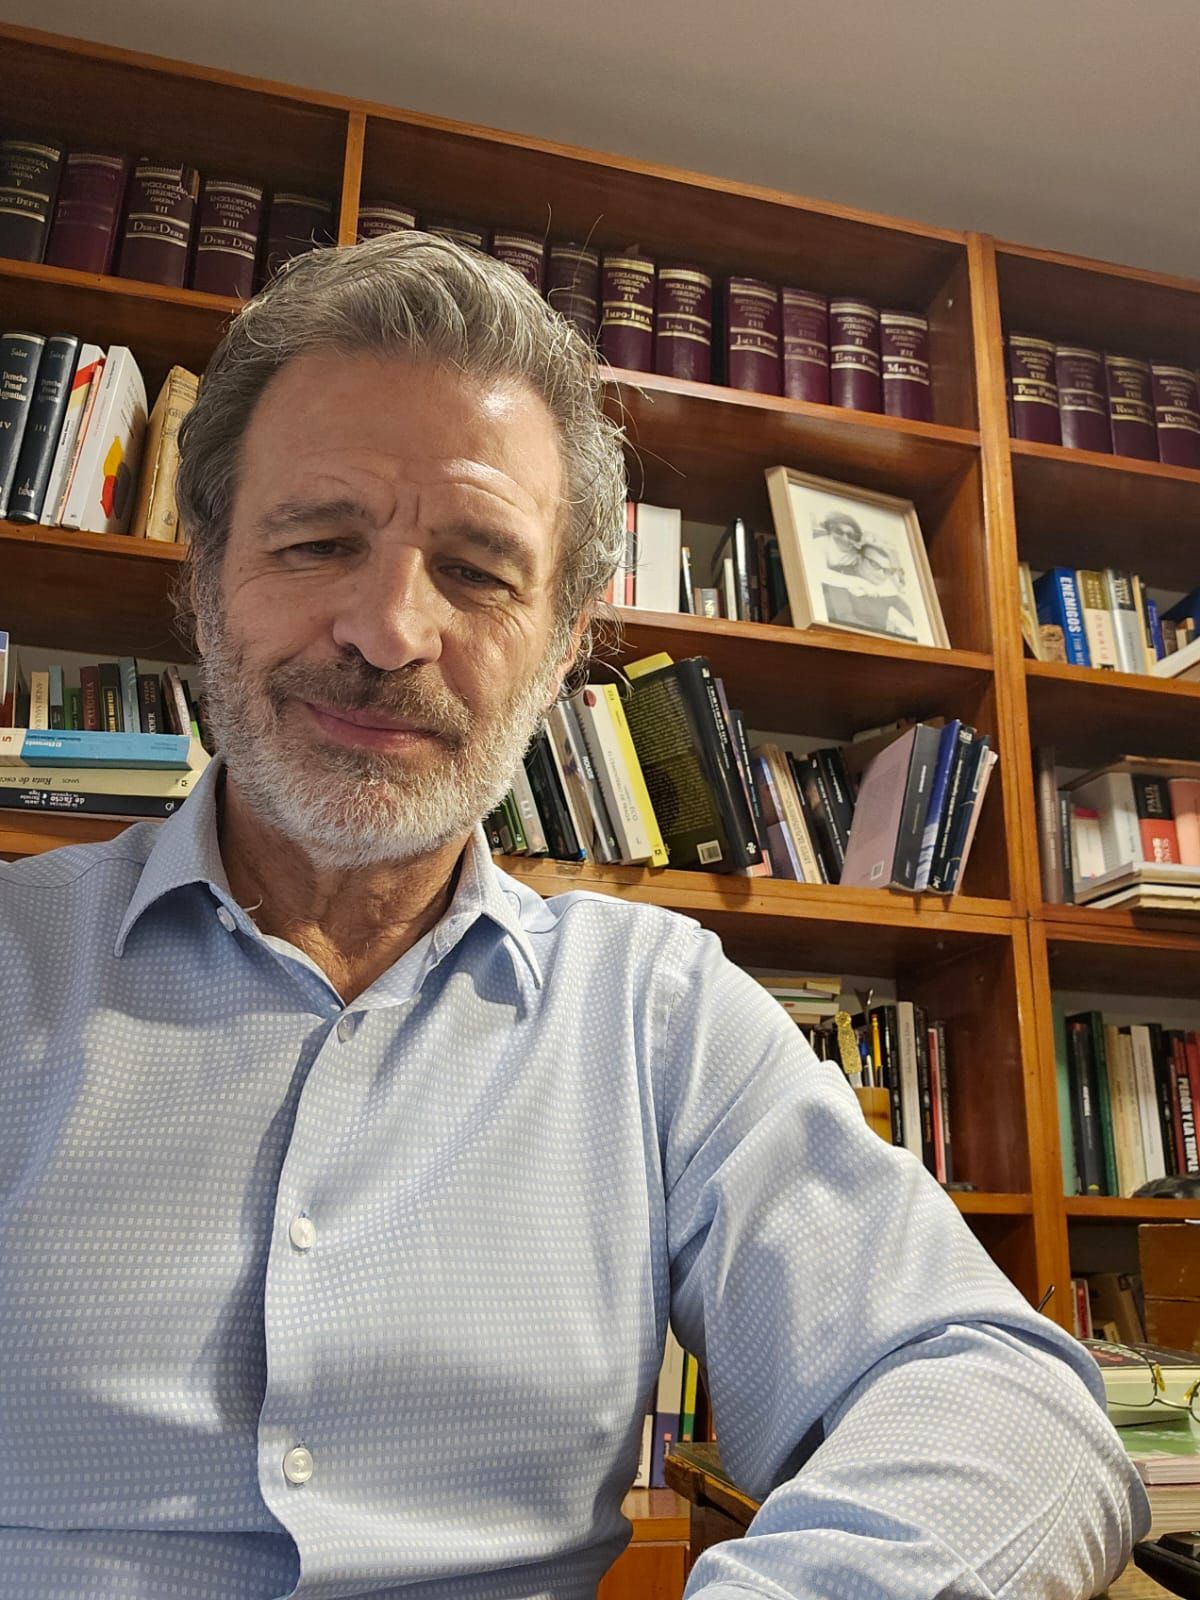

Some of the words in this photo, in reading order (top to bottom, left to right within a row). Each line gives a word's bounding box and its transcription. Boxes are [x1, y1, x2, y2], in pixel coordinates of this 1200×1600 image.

[3, 371, 28, 383] Derecho
[4, 380, 23, 391] Penal
[1059, 576, 1082, 634] ENEMIGOS
[581, 755, 595, 780] ROUGE
[18, 776, 30, 784] de
[31, 776, 53, 785] Ruta
[49, 795, 74, 804] facto
[74, 796, 86, 805] de
[1177, 1076, 1193, 1113] PERÓN
[1183, 1121, 1196, 1136] LA
[1184, 1136, 1200, 1173] TRIPLE
